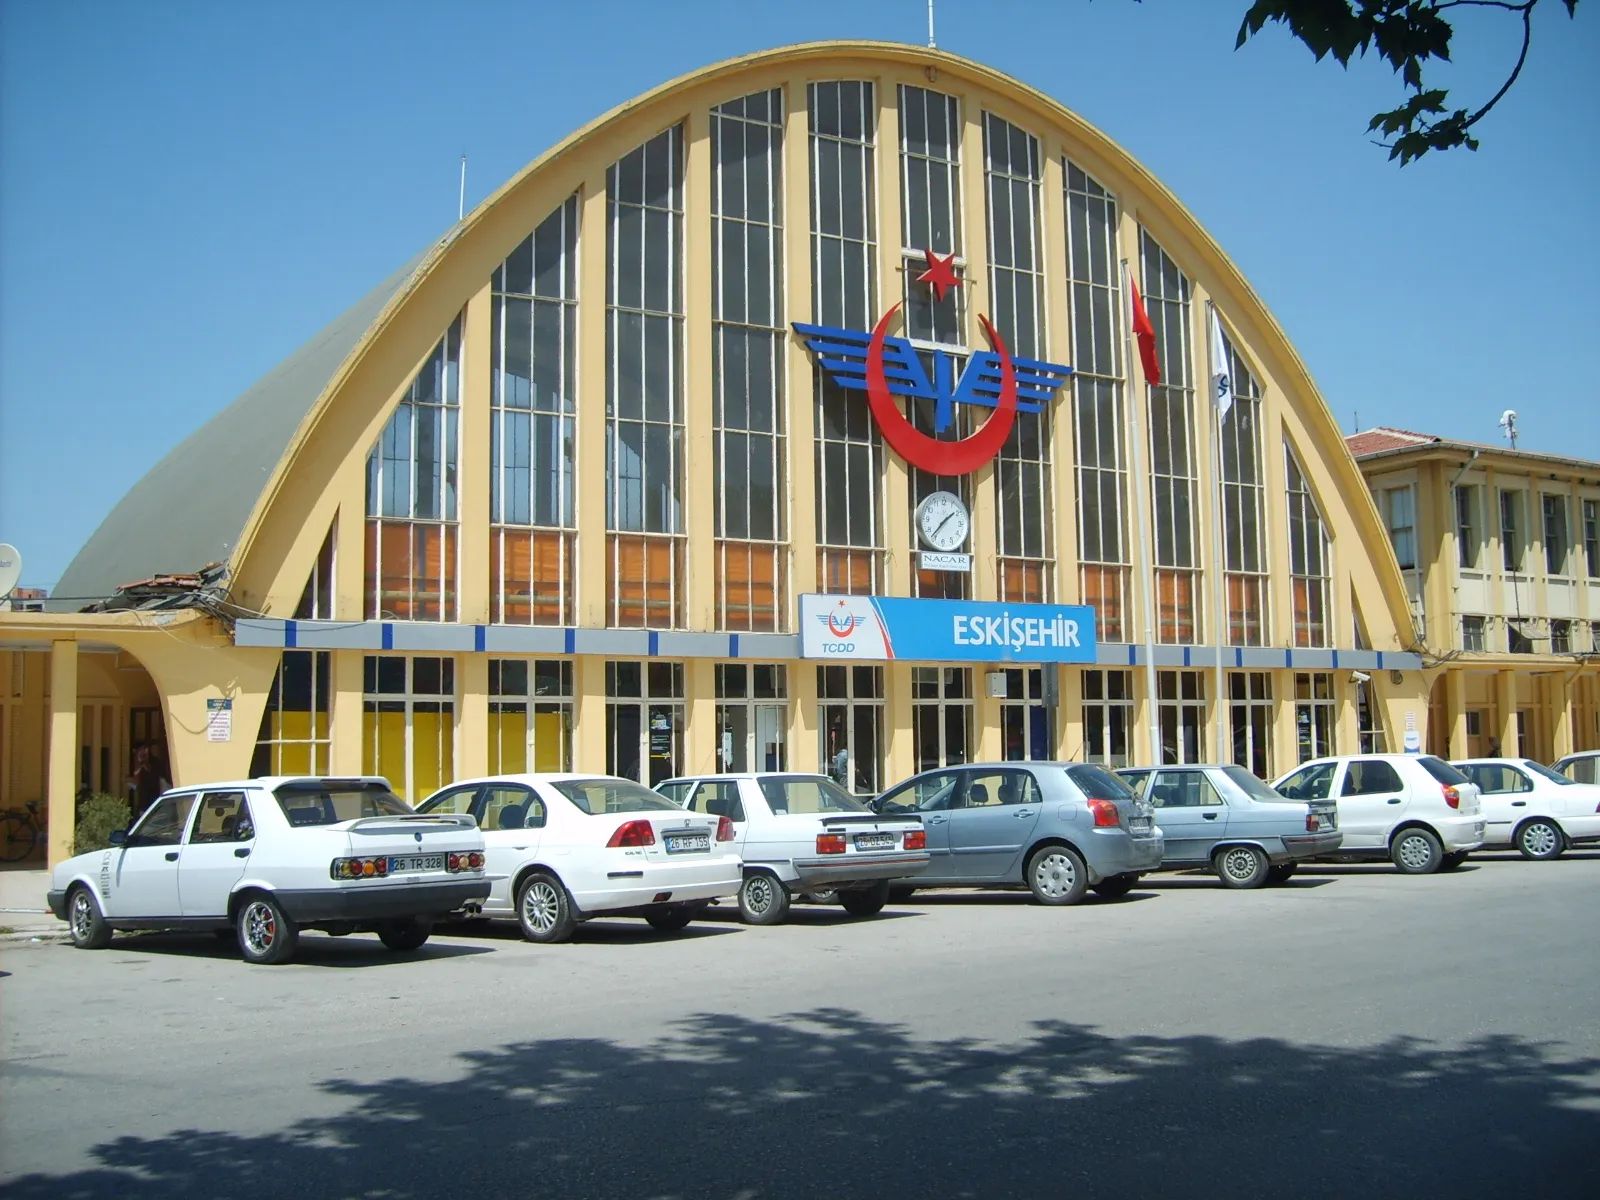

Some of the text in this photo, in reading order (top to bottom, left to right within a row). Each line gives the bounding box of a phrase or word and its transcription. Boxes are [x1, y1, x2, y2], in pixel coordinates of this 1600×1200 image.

[924, 555, 966, 563] NACAR
[953, 611, 1080, 652] ESKİŞEHİR
[822, 643, 855, 653] TCDD
[671, 836, 708, 848] 26 RF 155
[394, 857, 441, 870] 26 TR 328
